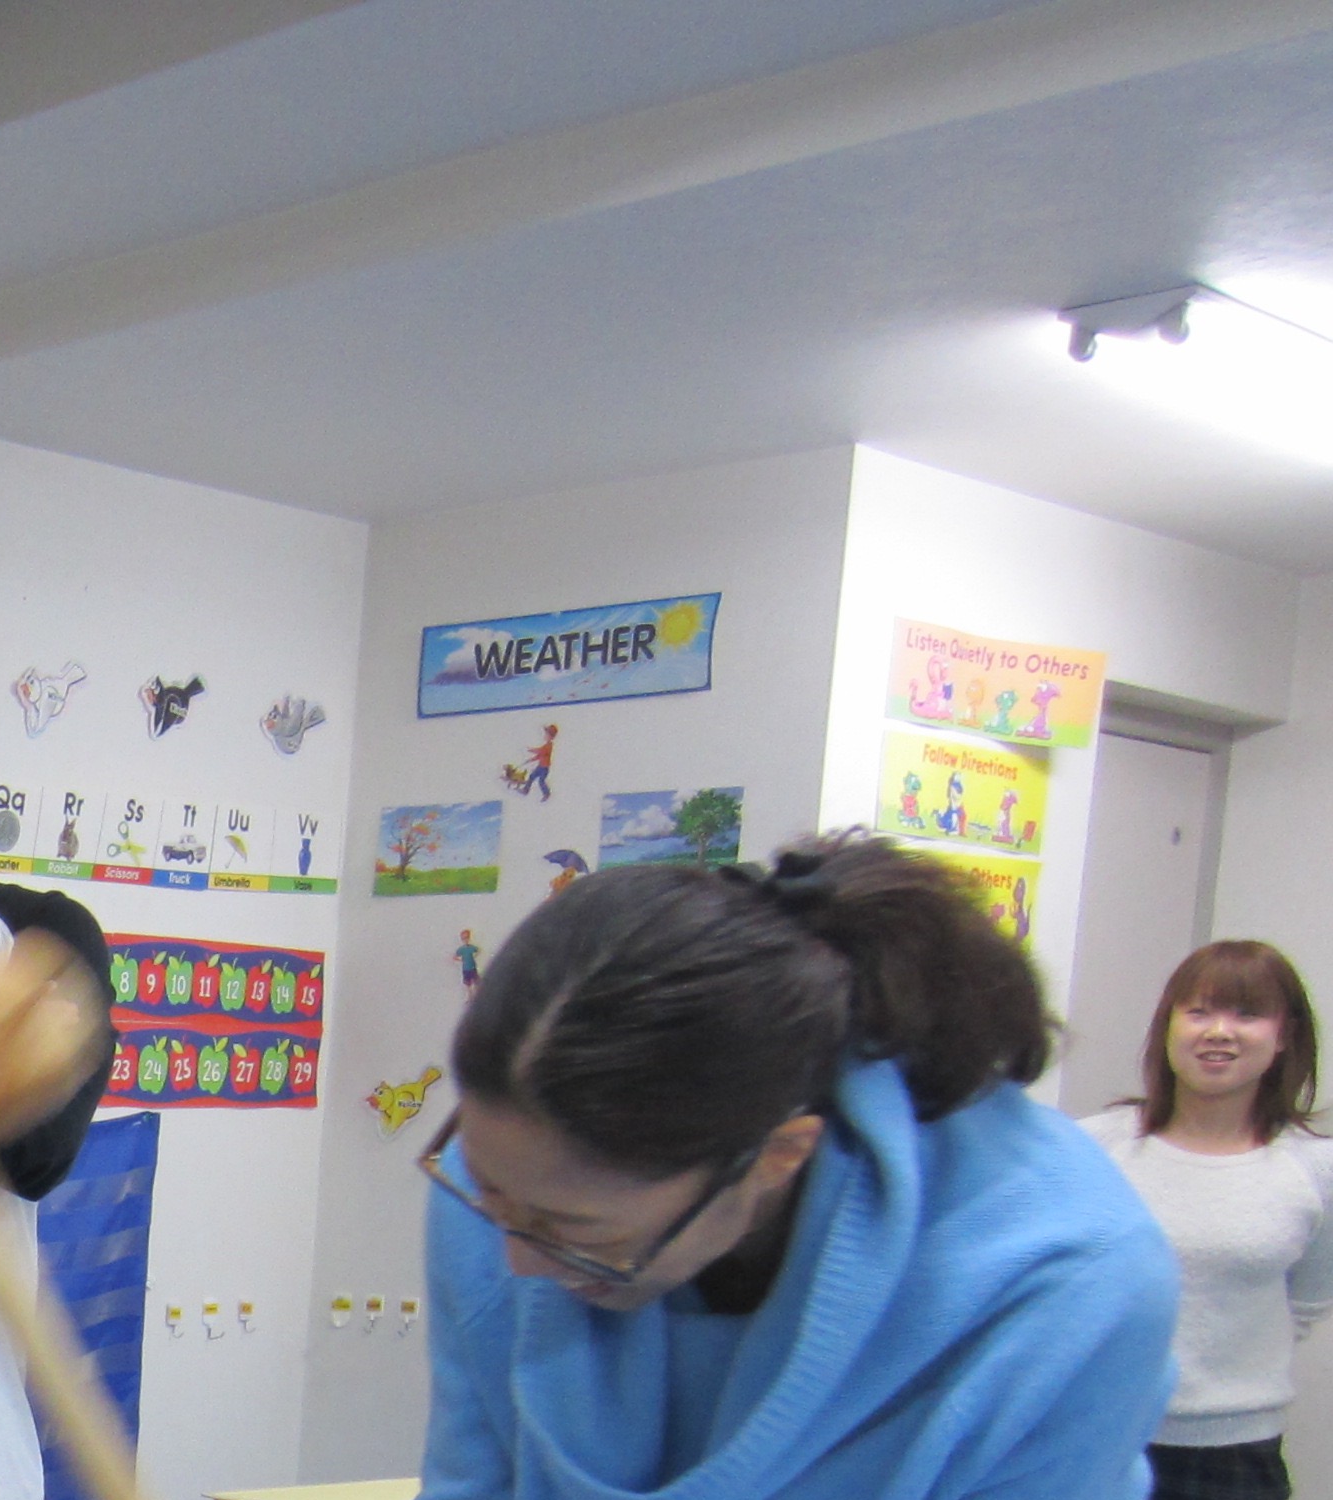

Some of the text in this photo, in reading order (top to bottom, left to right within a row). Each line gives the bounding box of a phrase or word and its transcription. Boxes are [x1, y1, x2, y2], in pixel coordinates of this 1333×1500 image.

[474, 623, 656, 679] WEATHER
[906, 627, 1089, 680] Listen Quietly to Others
[922, 744, 1019, 781] Follow Directions
[64, 792, 84, 817] Rr
[124, 799, 144, 823] Ss
[183, 804, 197, 828] Tt
[228, 809, 250, 833] Uu
[298, 814, 319, 837] Vv
[47, 861, 79, 876] Rabbit
[105, 865, 140, 881] Scissors
[168, 871, 191, 886] Truck
[971, 867, 1013, 889] Others
[214, 875, 251, 889] Umbrella
[119, 972, 130, 993] 8
[146, 974, 156, 994] 9
[171, 975, 186, 995] 10
[199, 976, 212, 997] 11
[226, 980, 240, 1000] 12
[251, 980, 265, 1001] 13
[276, 985, 290, 1003] 14
[301, 986, 316, 1005] 15
[111, 1059, 131, 1081] 23
[144, 1060, 162, 1081] 24
[174, 1058, 192, 1079] 25
[203, 1061, 221, 1082] 26
[236, 1061, 254, 1083] 27
[265, 1060, 283, 1081] 28
[294, 1062, 312, 1084] 29
